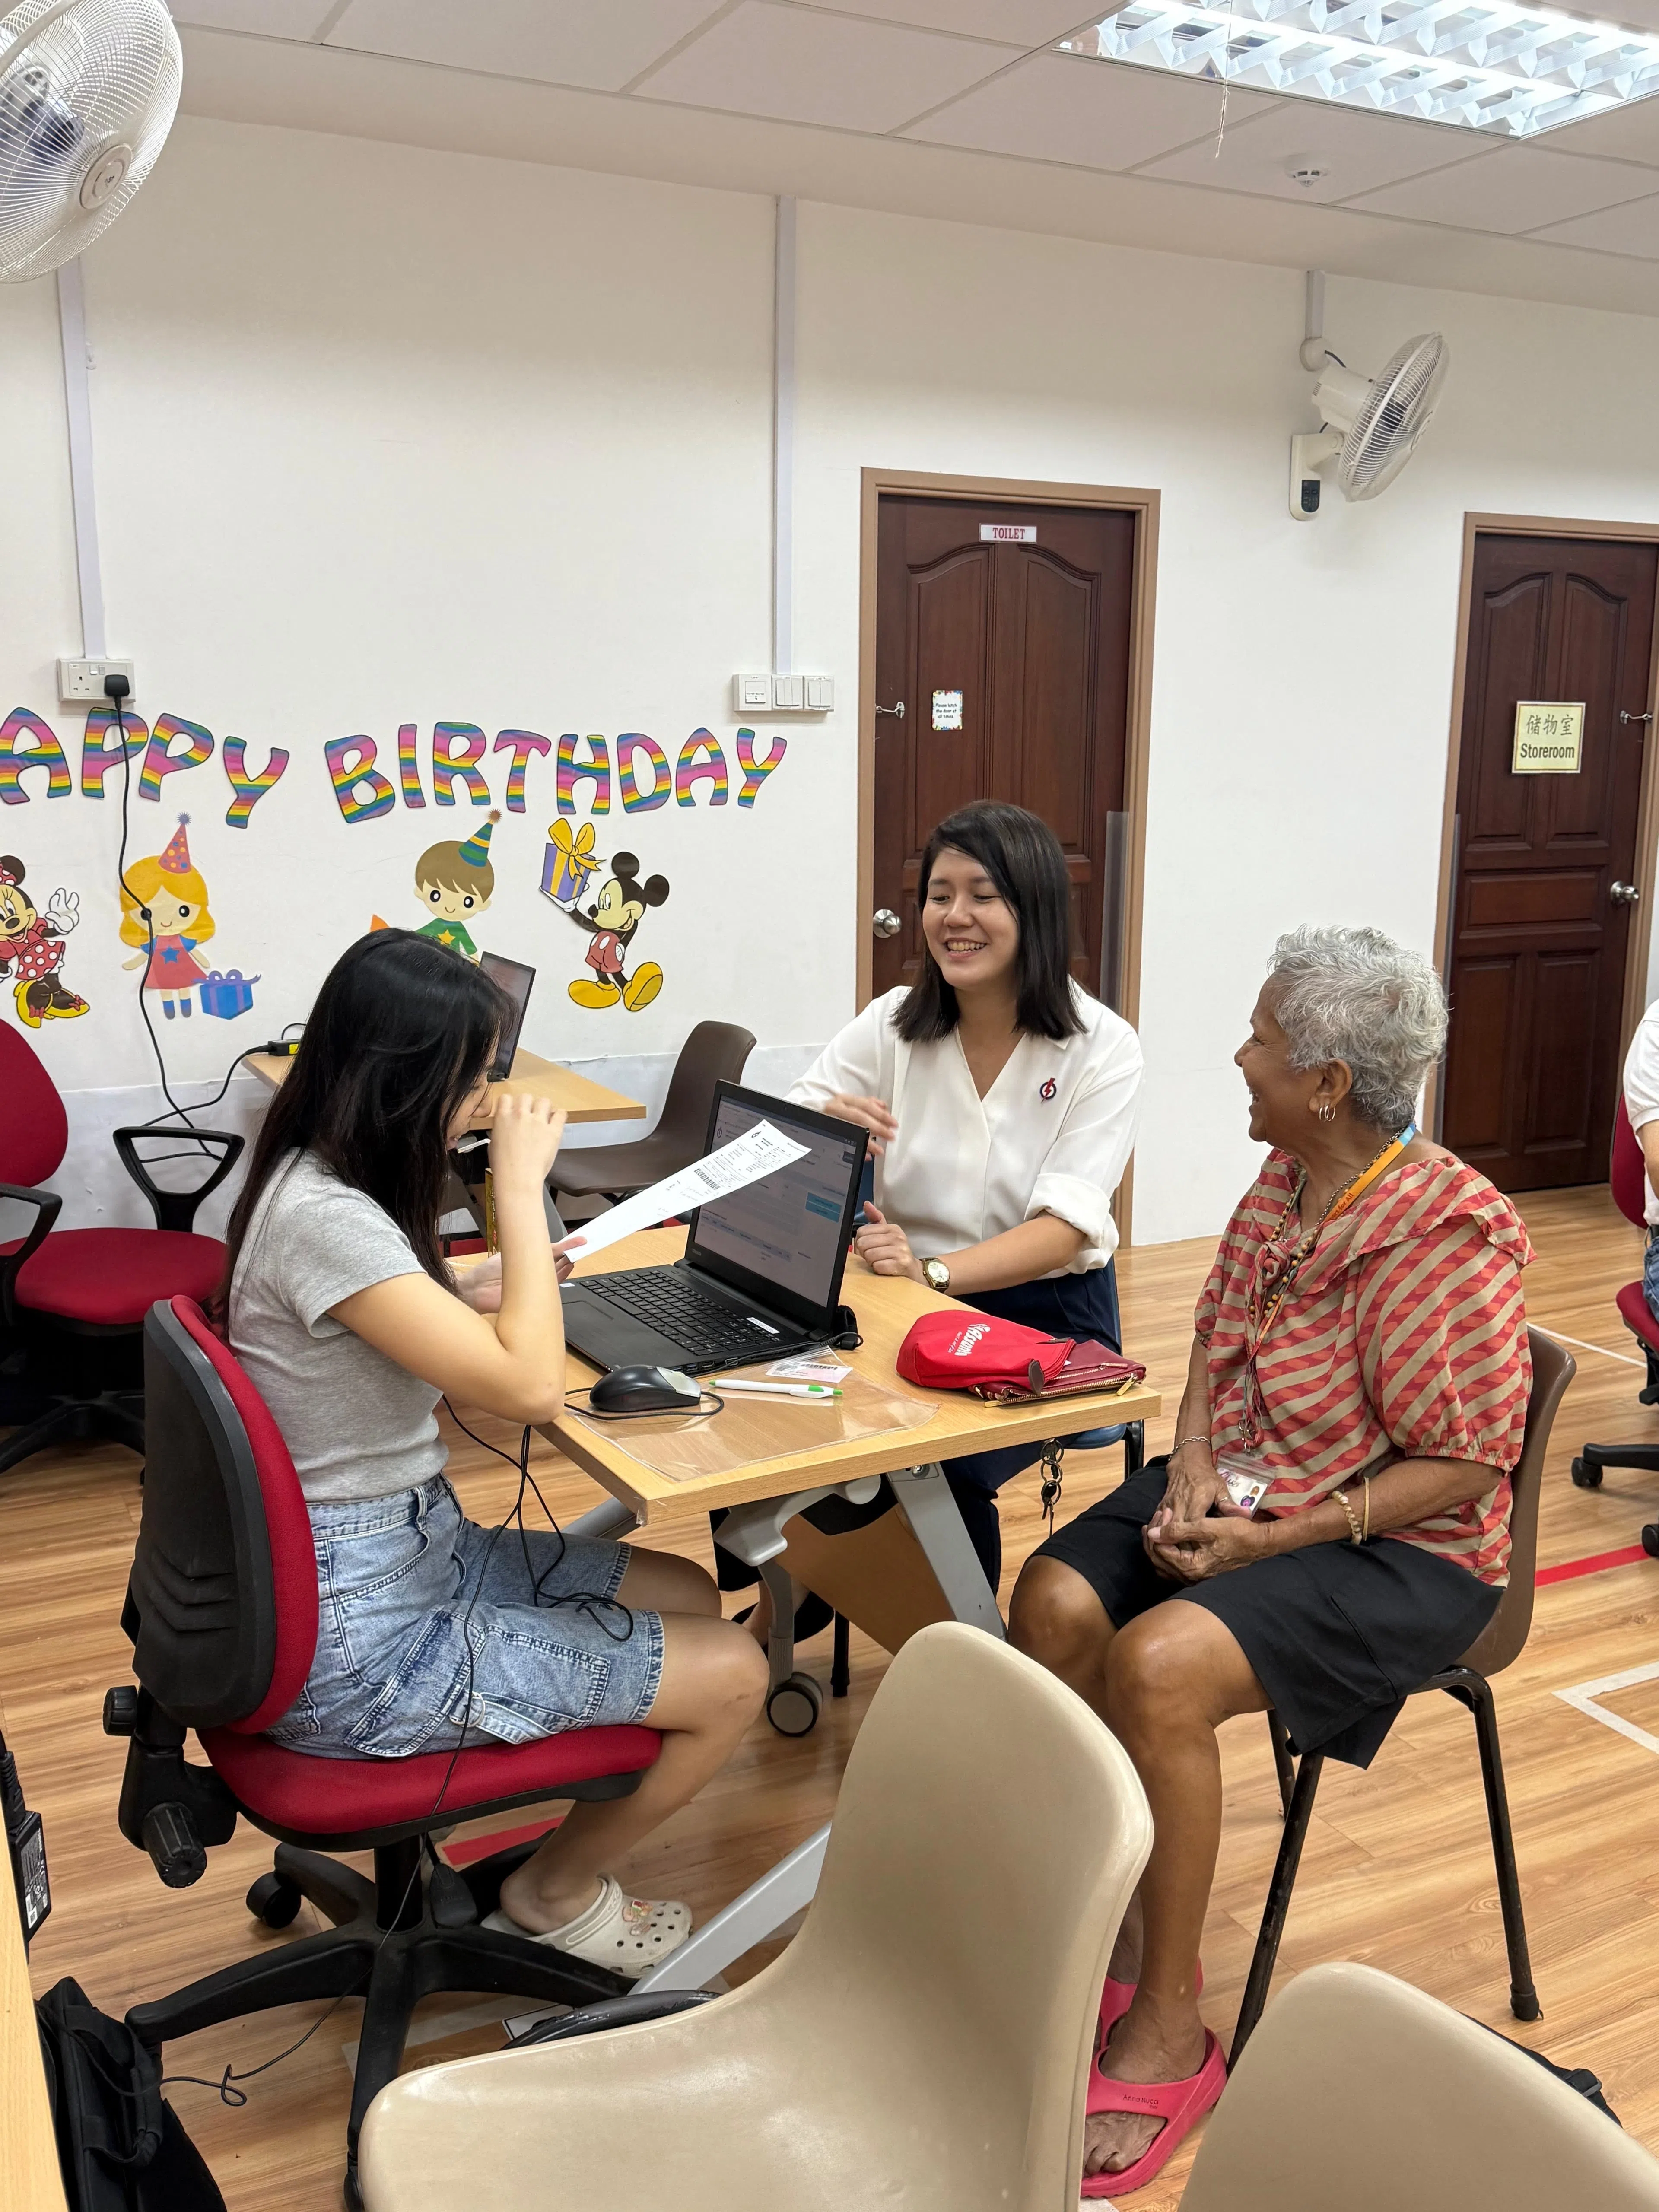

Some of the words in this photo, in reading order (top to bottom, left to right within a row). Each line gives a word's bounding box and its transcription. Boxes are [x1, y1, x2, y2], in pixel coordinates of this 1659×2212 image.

[992, 527, 1025, 540] TOILET
[1526, 713, 1574, 736] 储物室
[1520, 743, 1575, 759] Storeroom
[324, 721, 787, 823] BIRTHDAY
[1346, 1192, 1354, 1201] All
[1123, 2094, 1141, 2102] Anna
